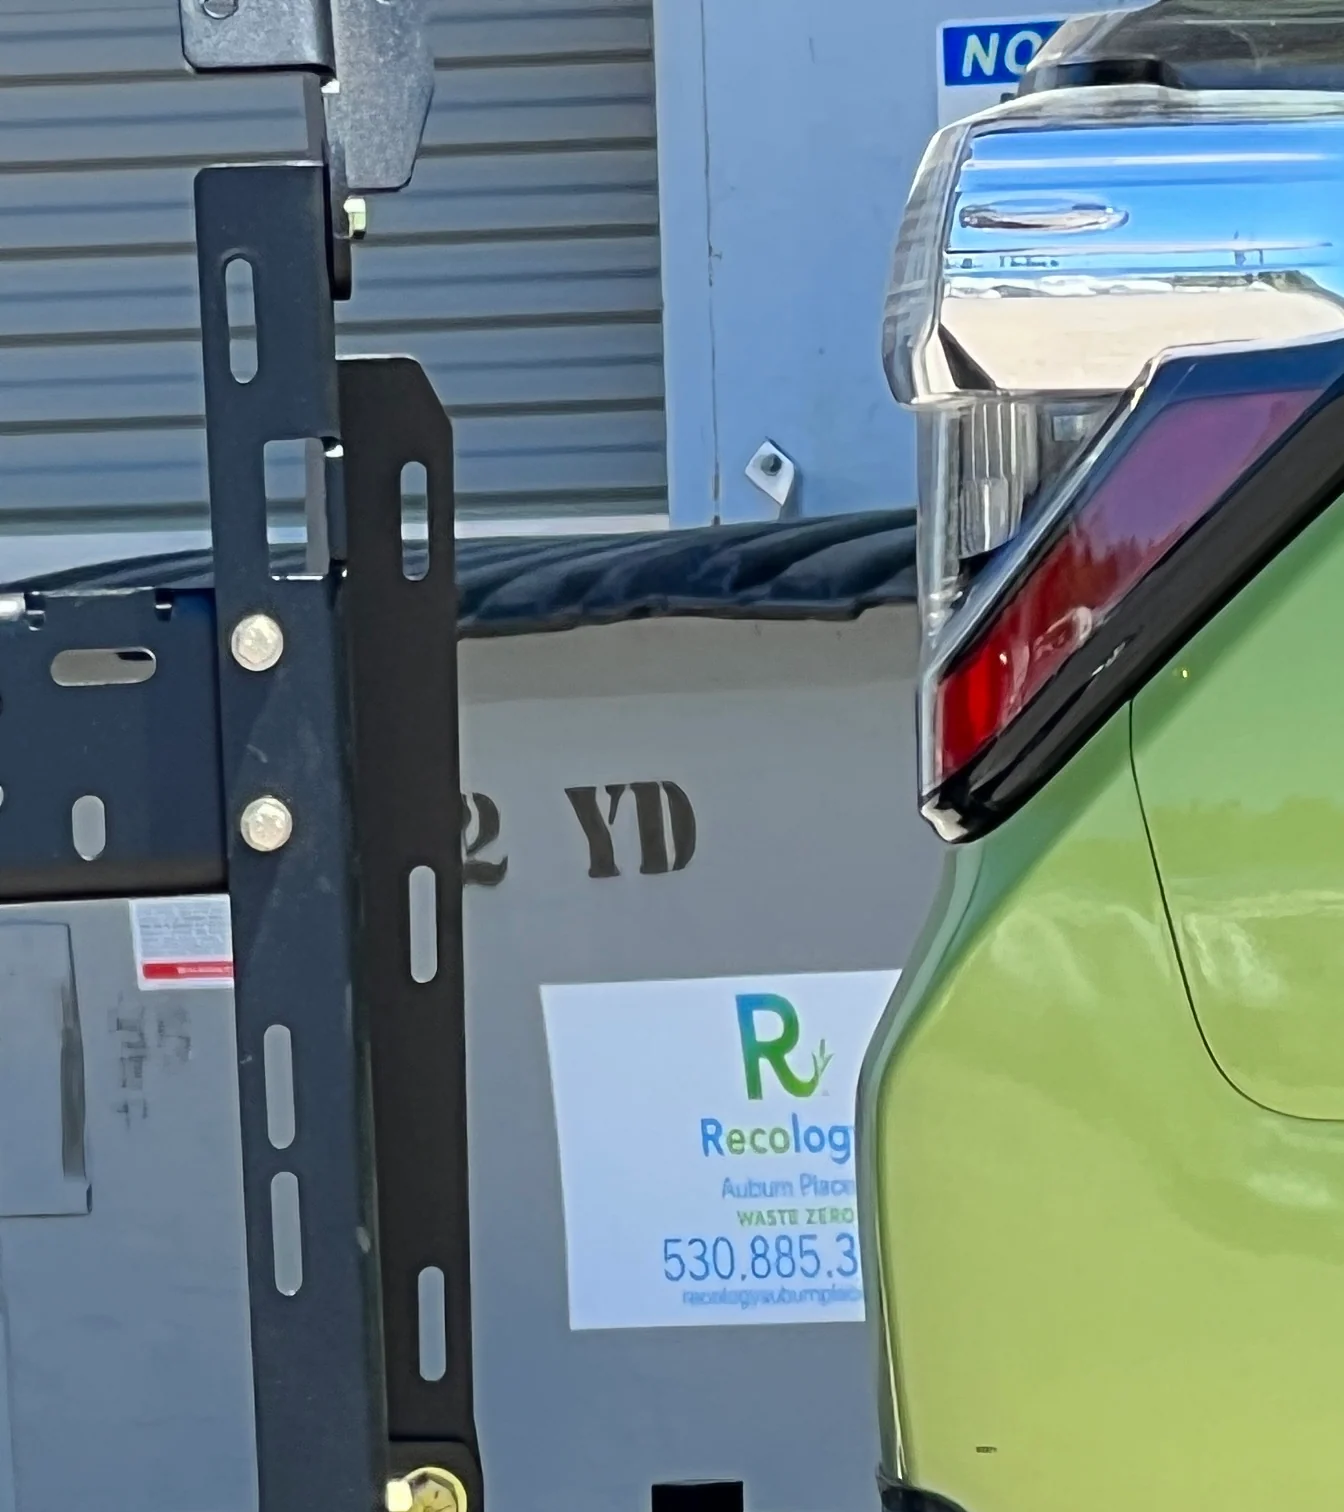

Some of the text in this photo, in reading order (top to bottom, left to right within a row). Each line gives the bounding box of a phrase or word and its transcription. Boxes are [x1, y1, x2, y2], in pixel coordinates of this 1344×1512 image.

[564, 780, 697, 879] YD
[700, 1112, 855, 1164] Recolog
[737, 1206, 855, 1227] WASTE ZERO
[664, 1232, 858, 1281] 530.885.3
